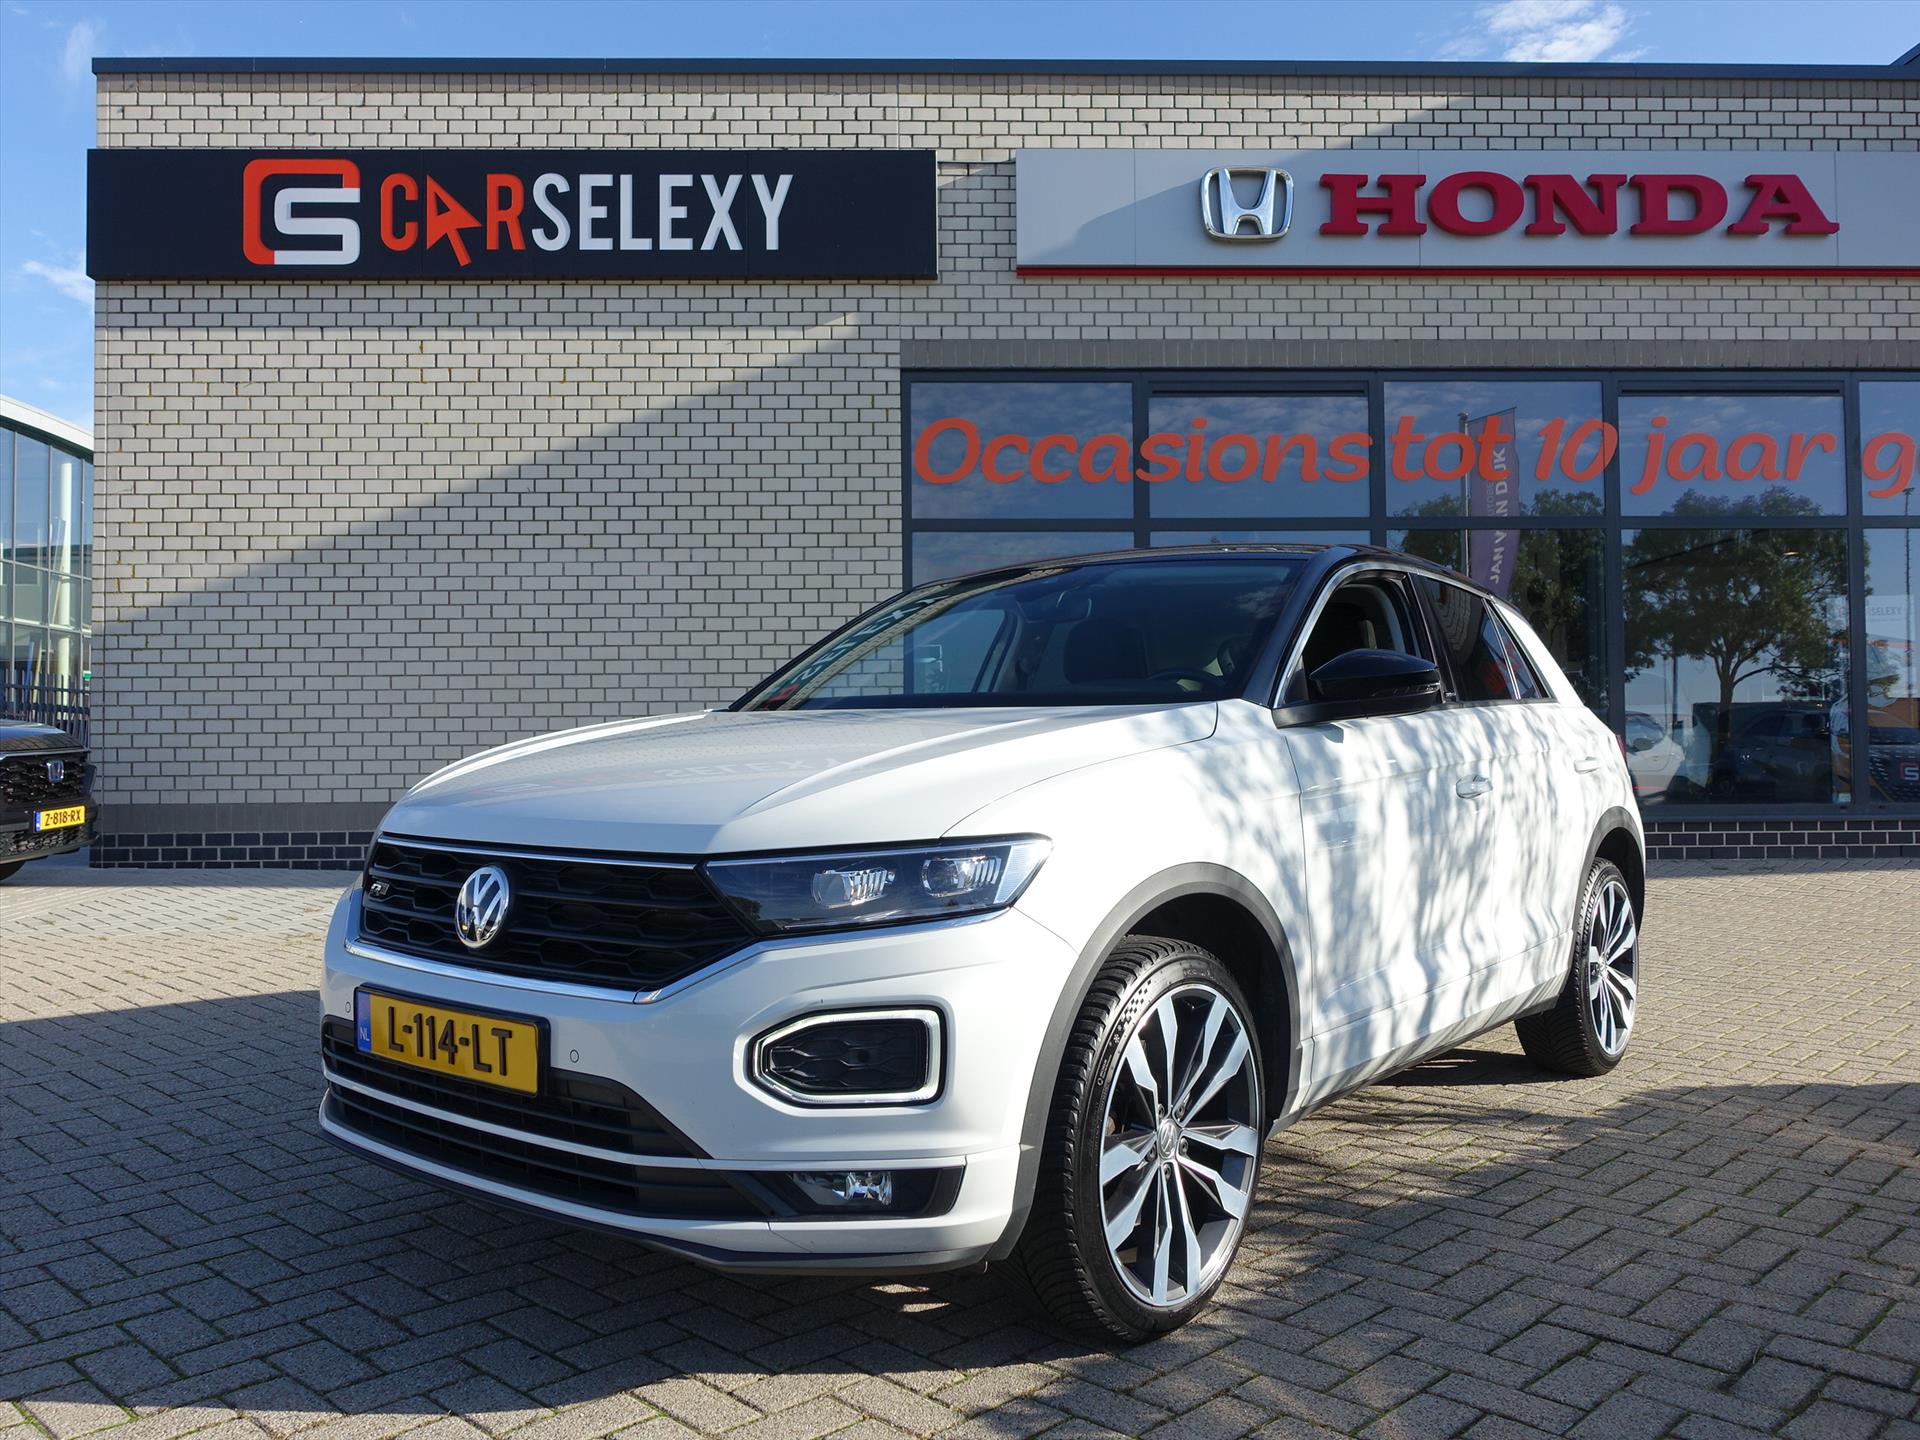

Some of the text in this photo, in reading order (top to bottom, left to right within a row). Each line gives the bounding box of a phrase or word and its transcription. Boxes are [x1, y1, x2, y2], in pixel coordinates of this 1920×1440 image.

[1319, 171, 1840, 236] HONDA
[914, 415, 1920, 498] Occasions tot 10 jaar g
[1494, 500, 1508, 545] VN
[45, 809, 82, 827] Z-818-RX
[388, 1006, 513, 1076] L-114-LT
